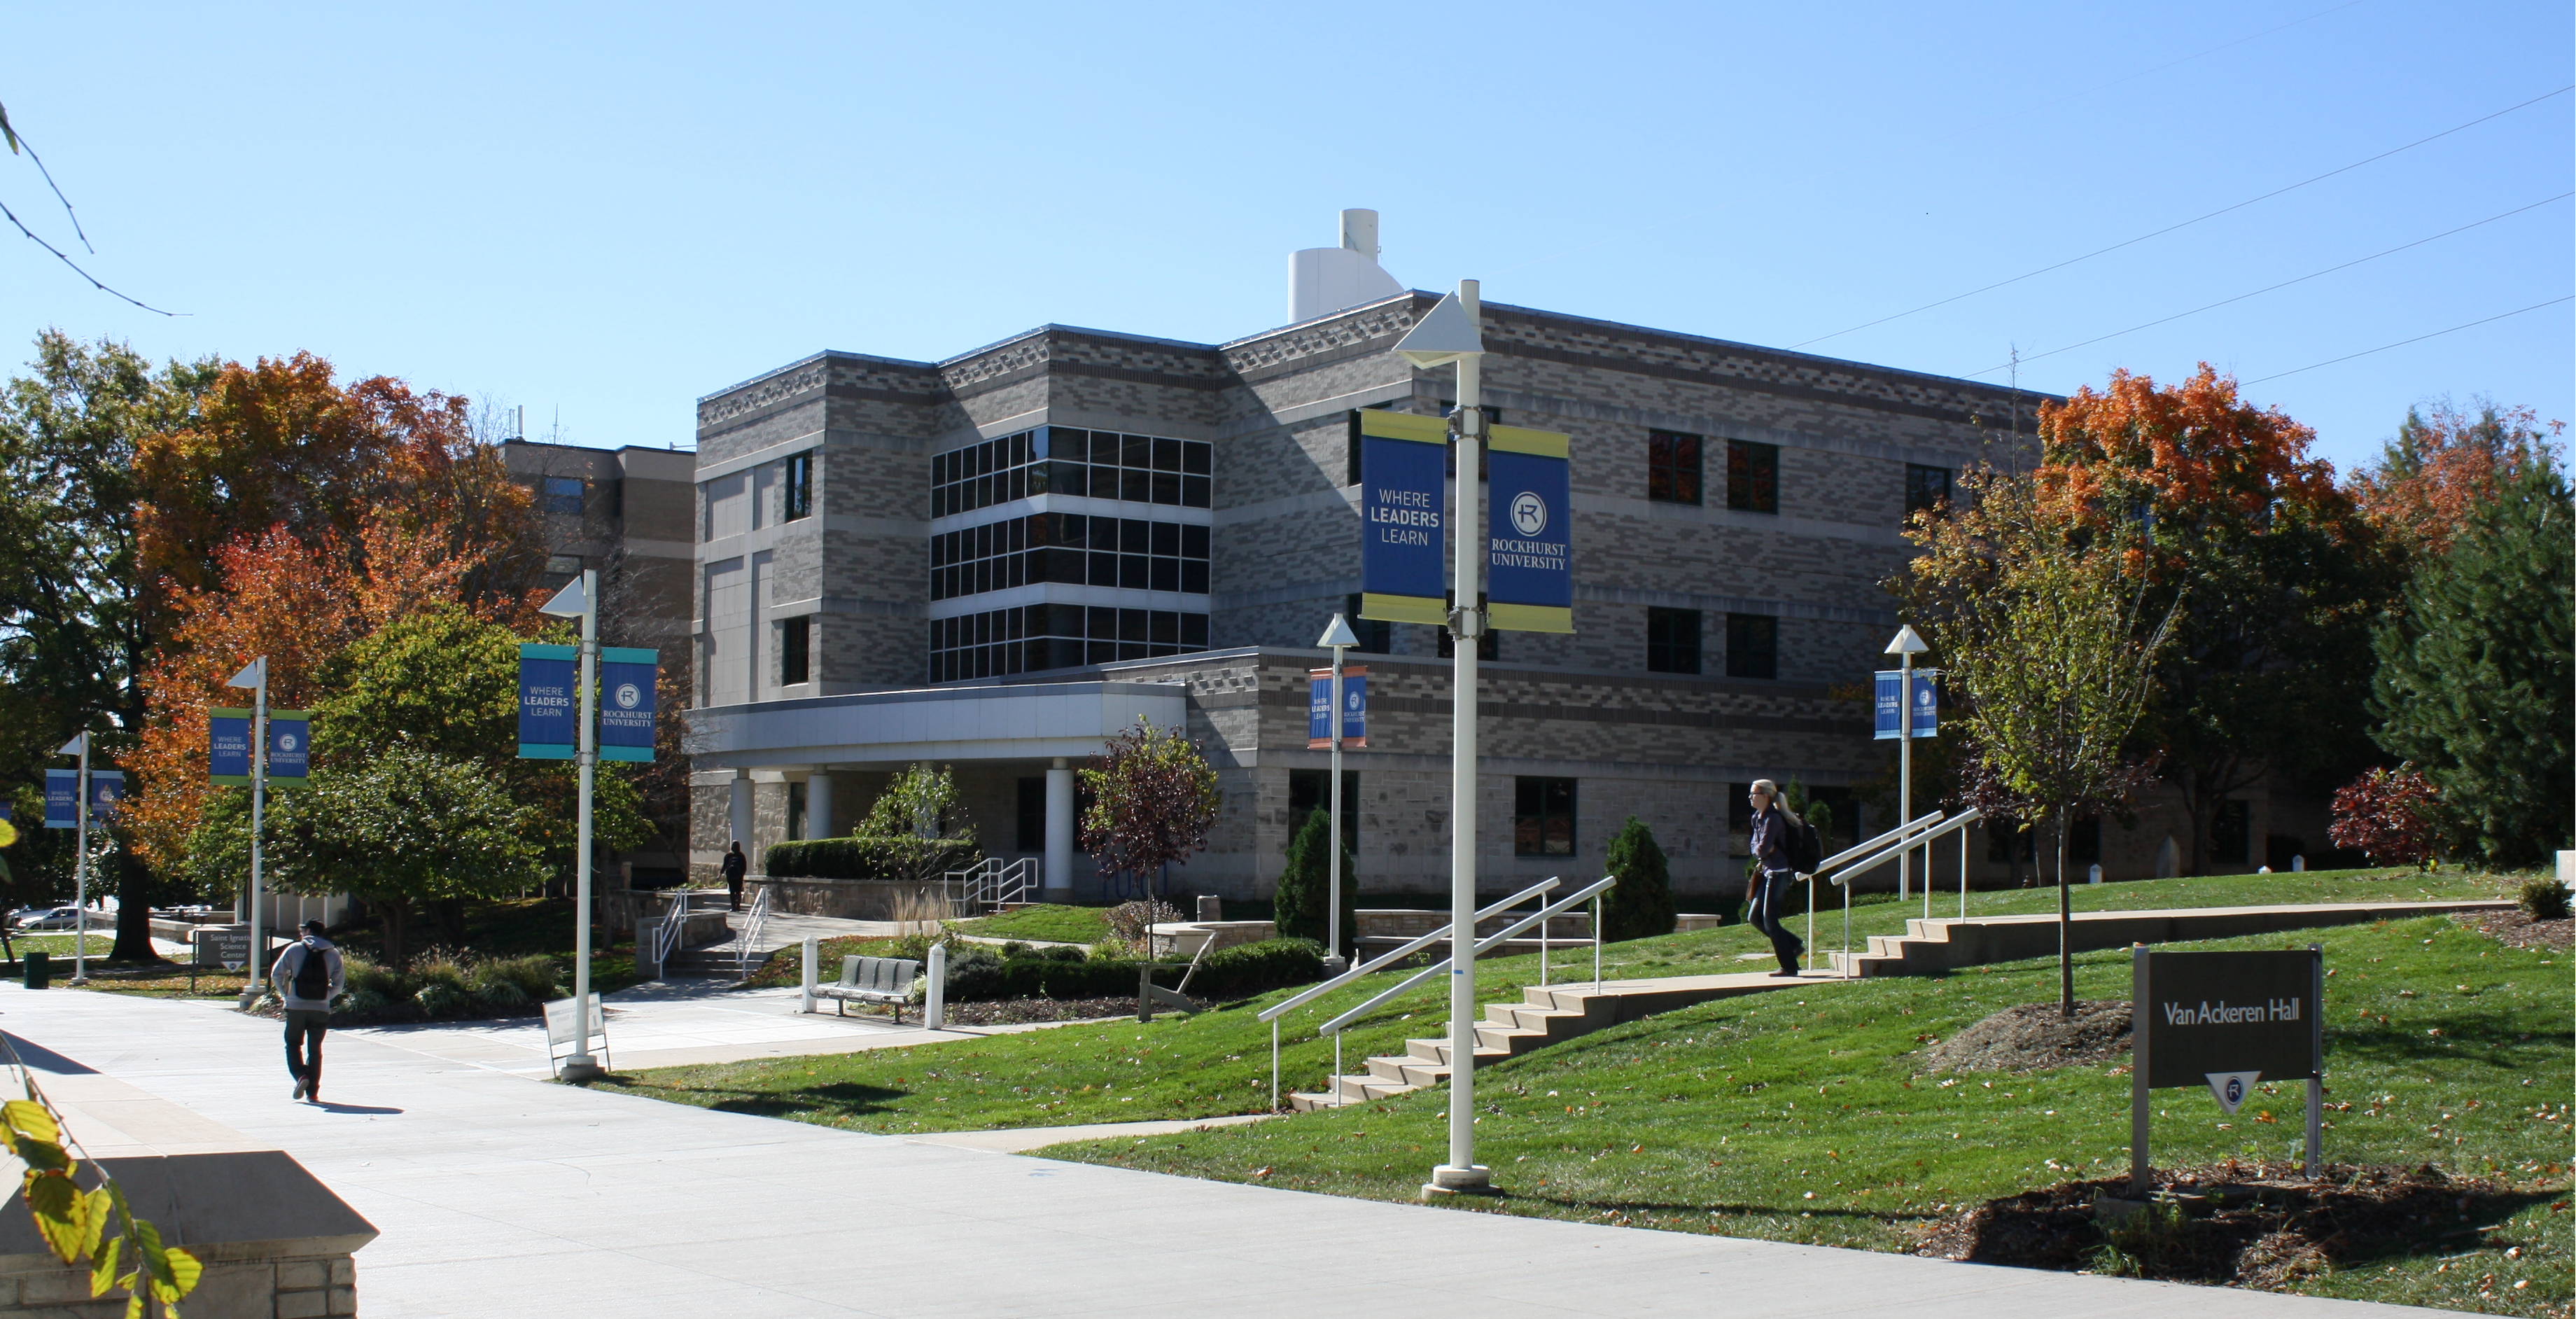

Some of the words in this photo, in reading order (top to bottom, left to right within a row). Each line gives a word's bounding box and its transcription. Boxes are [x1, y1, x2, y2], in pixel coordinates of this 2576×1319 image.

[1379, 489, 1430, 508] WHERE
[1371, 506, 1439, 527] LEADERS
[1382, 528, 1428, 546] LEARN
[1492, 538, 1565, 556] ROCKHURST
[1492, 552, 1566, 571] UNIVERSITY
[530, 686, 564, 696] WHERE
[525, 697, 569, 706] LEADERS
[1312, 704, 1330, 713] LEADERS
[531, 708, 562, 717] LEARN
[603, 710, 652, 719] ROCKHURST
[603, 718, 652, 727] UNIVERSITY
[2164, 1001, 2195, 1026] Van
[2197, 1000, 2264, 1024] Ackeren
[2269, 998, 2300, 1021] Hall
